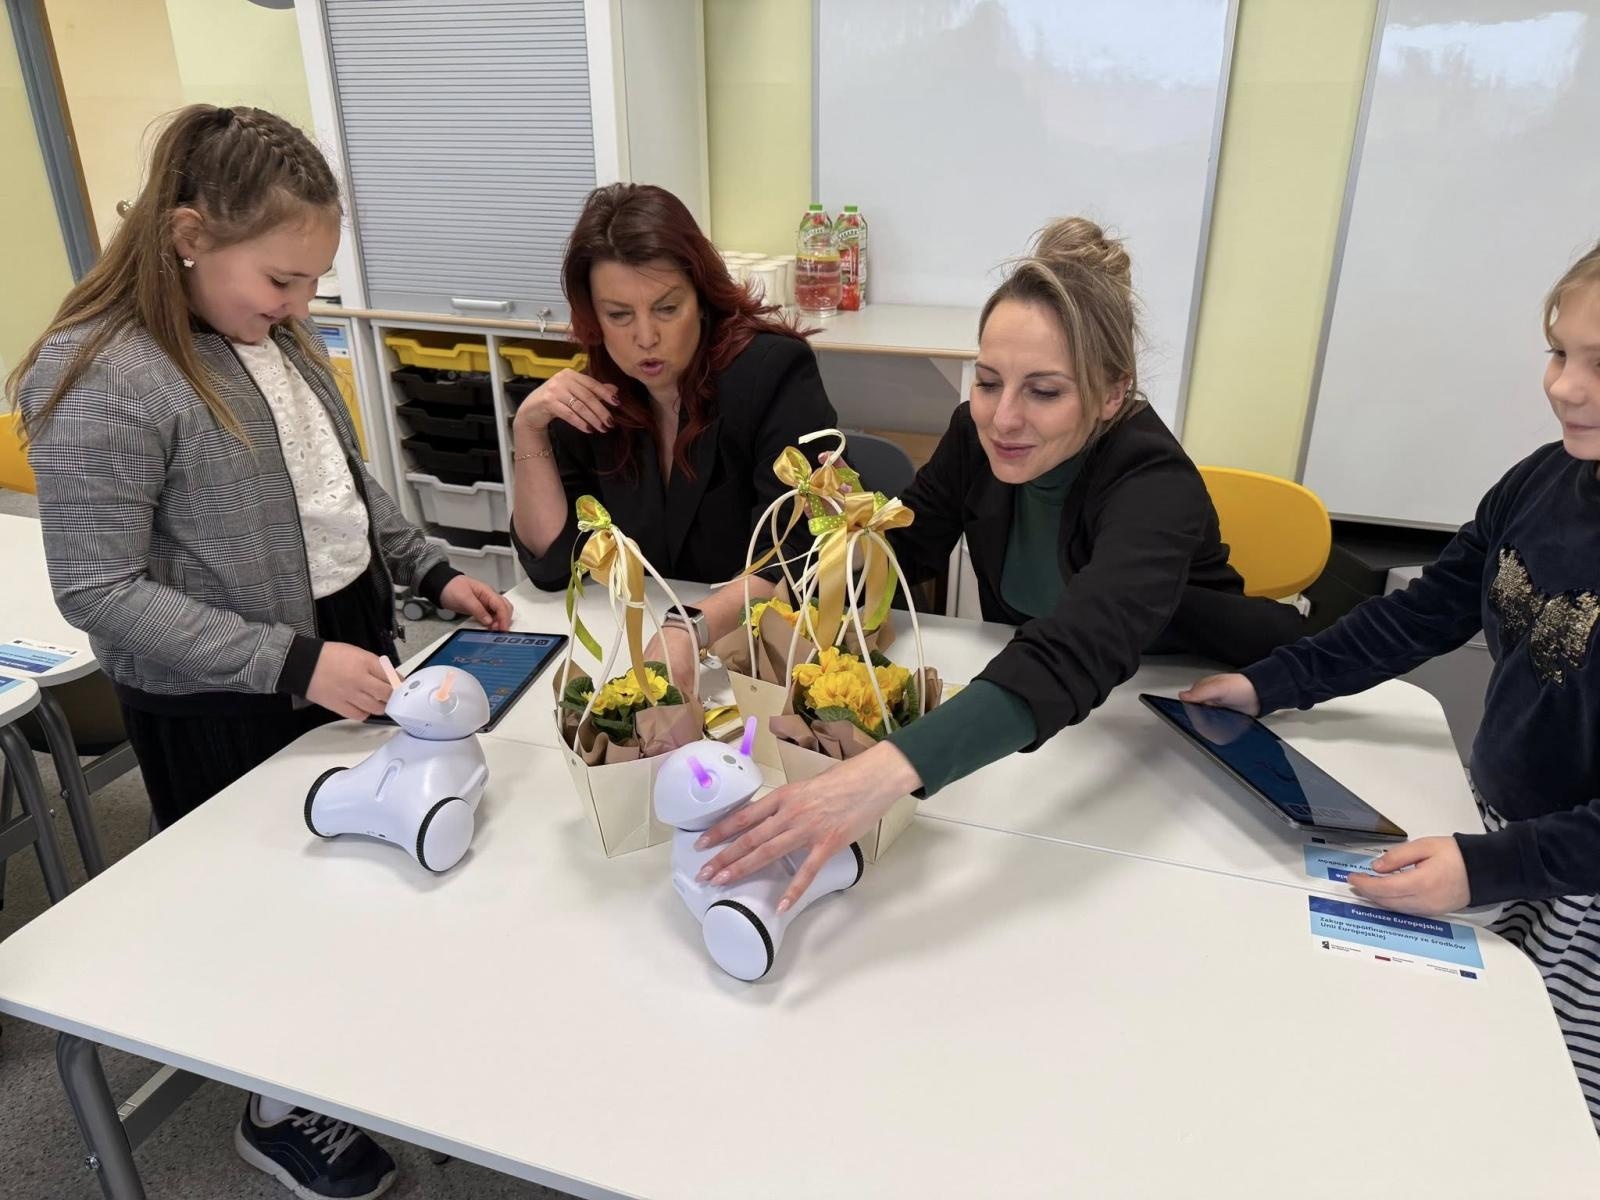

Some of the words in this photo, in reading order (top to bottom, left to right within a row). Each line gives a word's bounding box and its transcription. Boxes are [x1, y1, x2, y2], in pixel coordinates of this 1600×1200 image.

[1320, 917, 1344, 926] Zakup
[1351, 908, 1392, 921] Fundusze
[1393, 917, 1444, 932] Europejskie
[1338, 925, 1386, 940] Europejskiej
